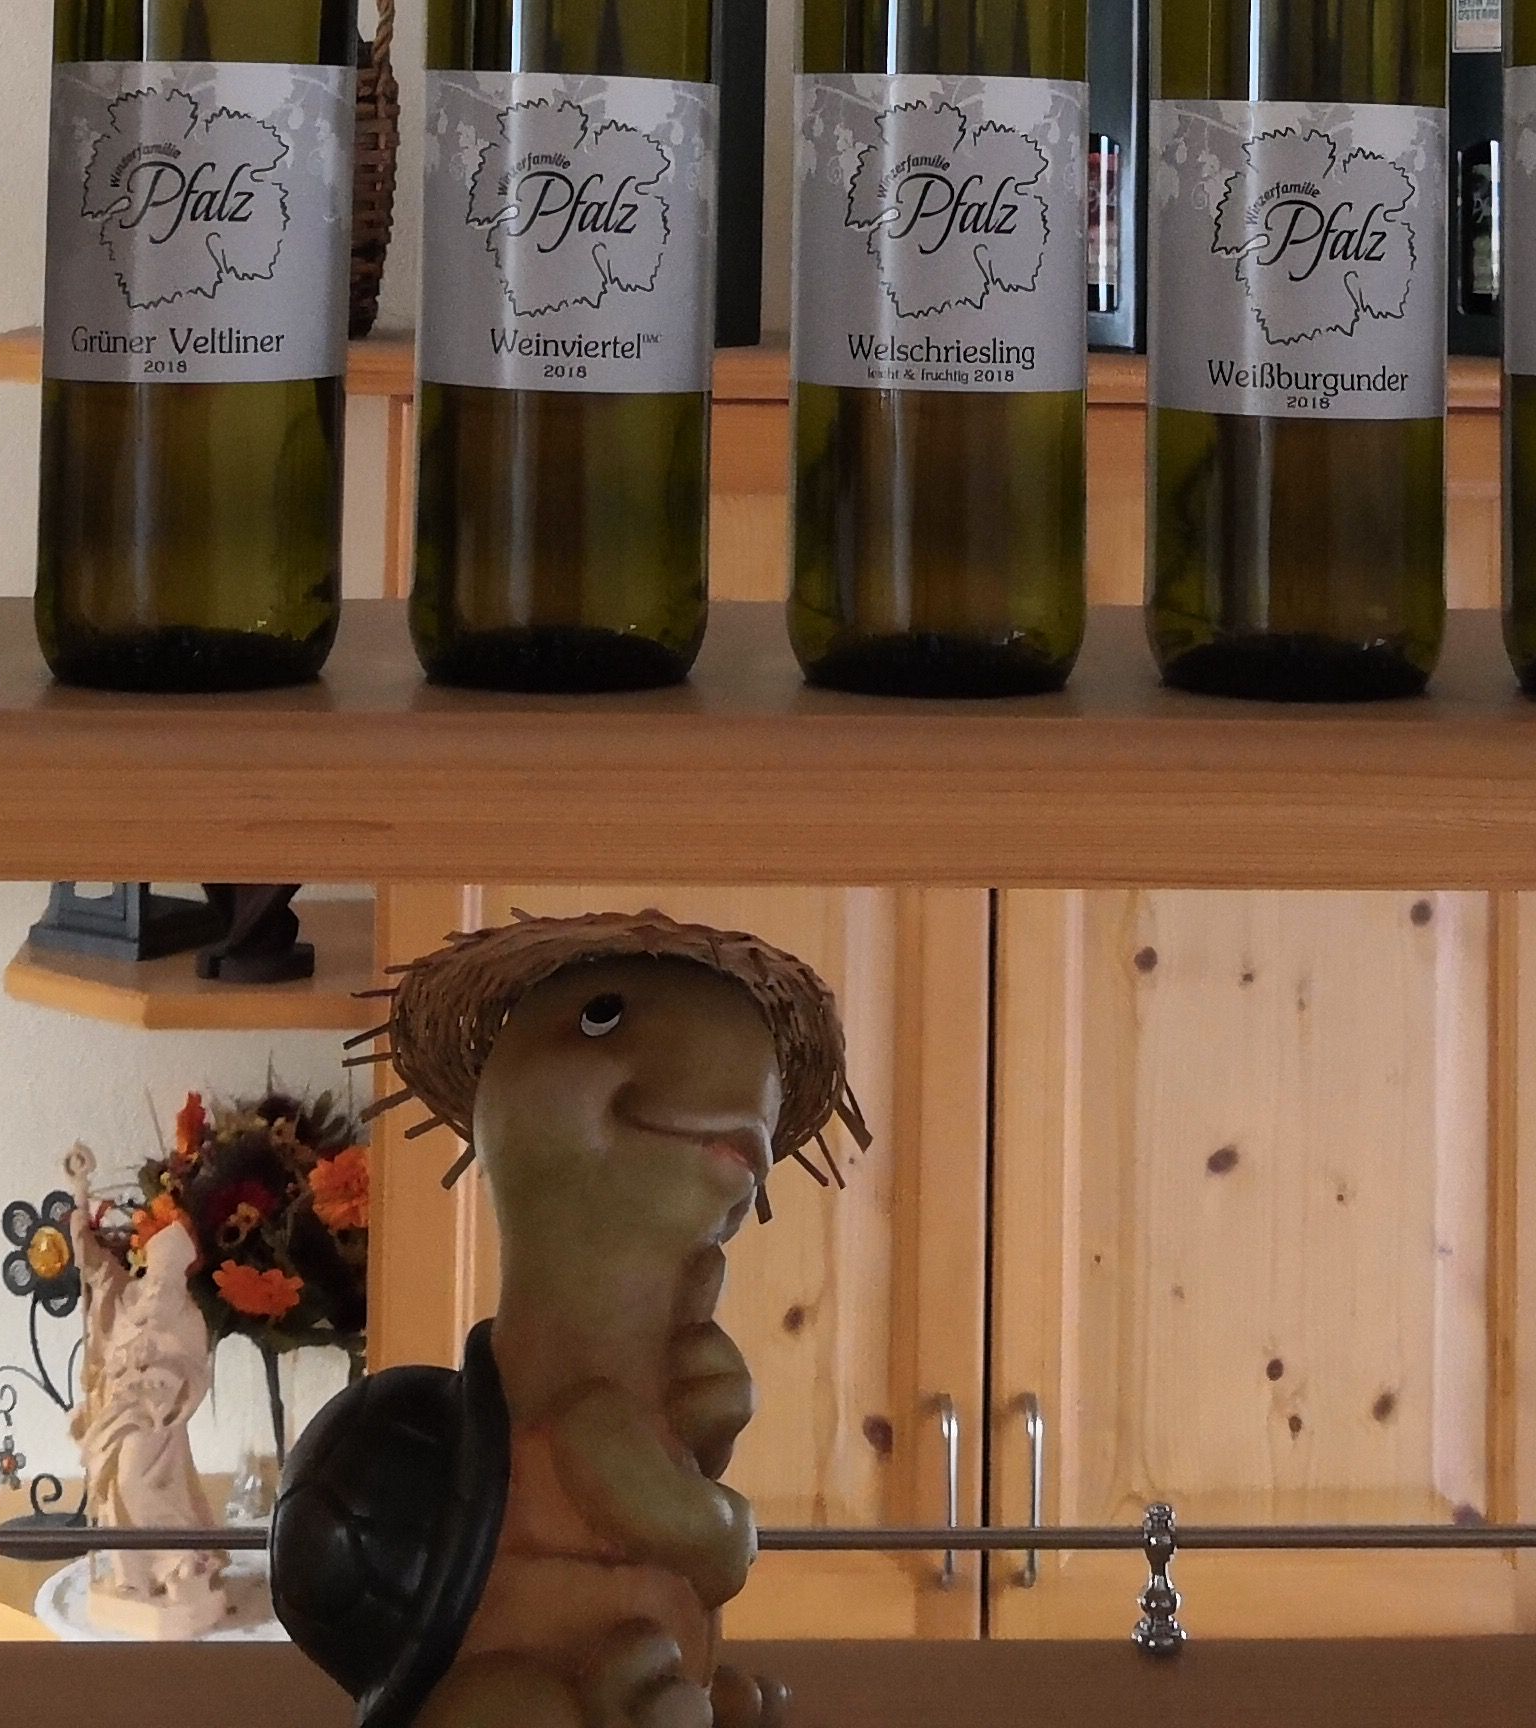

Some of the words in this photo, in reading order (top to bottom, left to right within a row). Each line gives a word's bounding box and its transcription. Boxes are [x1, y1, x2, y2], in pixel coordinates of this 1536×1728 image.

[119, 161, 254, 244] Pfalz
[507, 171, 639, 253] Pfalz
[888, 173, 1018, 255] Pfalz
[1257, 199, 1387, 282] Pfalz
[72, 326, 156, 354] Grüner
[169, 328, 284, 354] Veltliner
[490, 328, 642, 359] Weinviertel
[847, 334, 1035, 369] Welschriesling
[144, 360, 187, 373] 2018
[544, 365, 587, 378] 2018
[974, 369, 1014, 382] 2018
[1208, 359, 1409, 397] Weißburgunder
[1287, 395, 1330, 410] 2018
